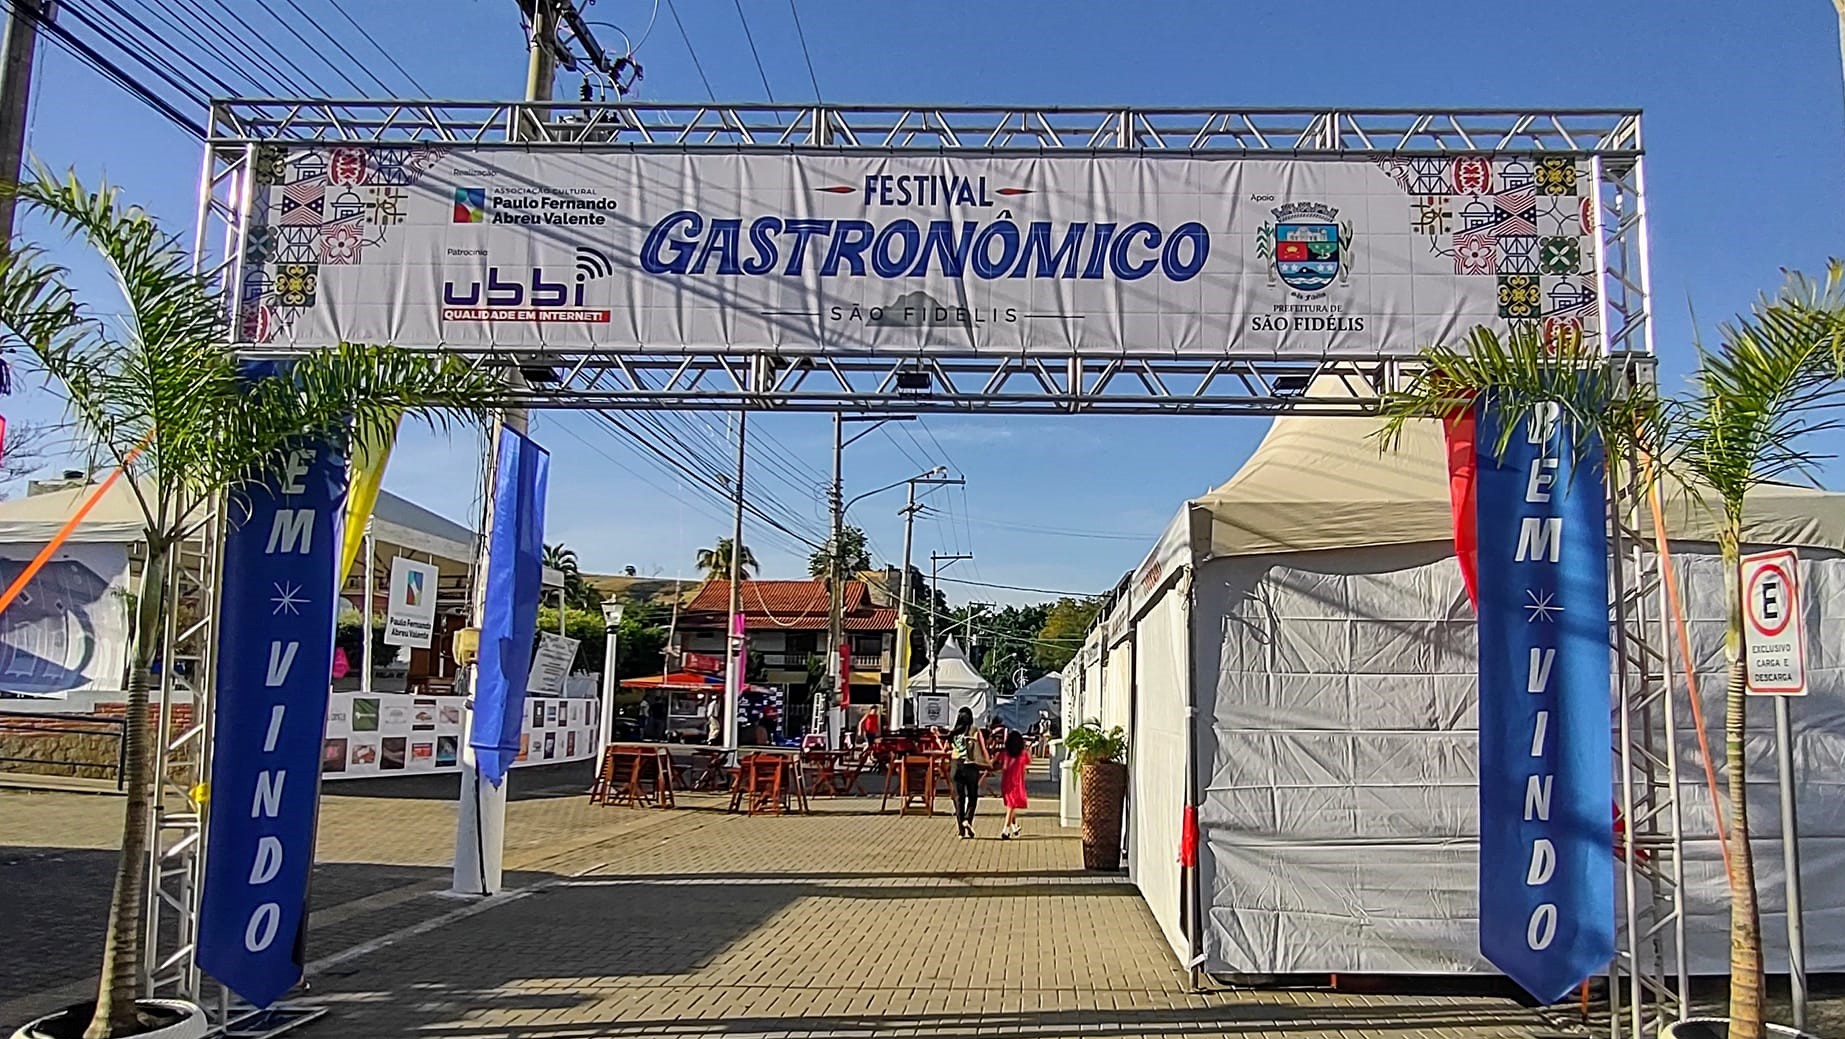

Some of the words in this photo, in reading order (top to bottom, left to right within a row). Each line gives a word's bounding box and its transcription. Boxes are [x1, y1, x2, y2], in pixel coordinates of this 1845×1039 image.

[552, 188, 597, 196] CULTURAL
[864, 175, 994, 207] FESTIVAL
[1250, 193, 1275, 202] Apoio
[492, 197, 539, 209] Paulo
[541, 197, 617, 210] Fernando
[492, 212, 541, 224] Abreu
[543, 212, 606, 225] Valente
[640, 210, 1210, 282] GASTRONÔMICO
[444, 267, 585, 307] ubbi
[830, 303, 884, 321] SÃO
[1273, 304, 1328, 313] PREFEITURA
[1330, 304, 1343, 313] DE
[444, 310, 516, 320] QUALIDADE
[517, 310, 536, 320] EM
[539, 311, 603, 321] INTERNET!
[1252, 314, 1289, 331] SÃO
[1294, 314, 1365, 331] FIDÉLIS
[1762, 583, 1778, 619] E
[1752, 643, 1791, 654] EXCLUSIVO
[1756, 659, 1781, 668] CARGA
[1784, 658, 1789, 667] E
[1755, 673, 1792, 682] DESCARGA
[245, 640, 299, 952] VINDO
[1523, 647, 1557, 951] VINDO
